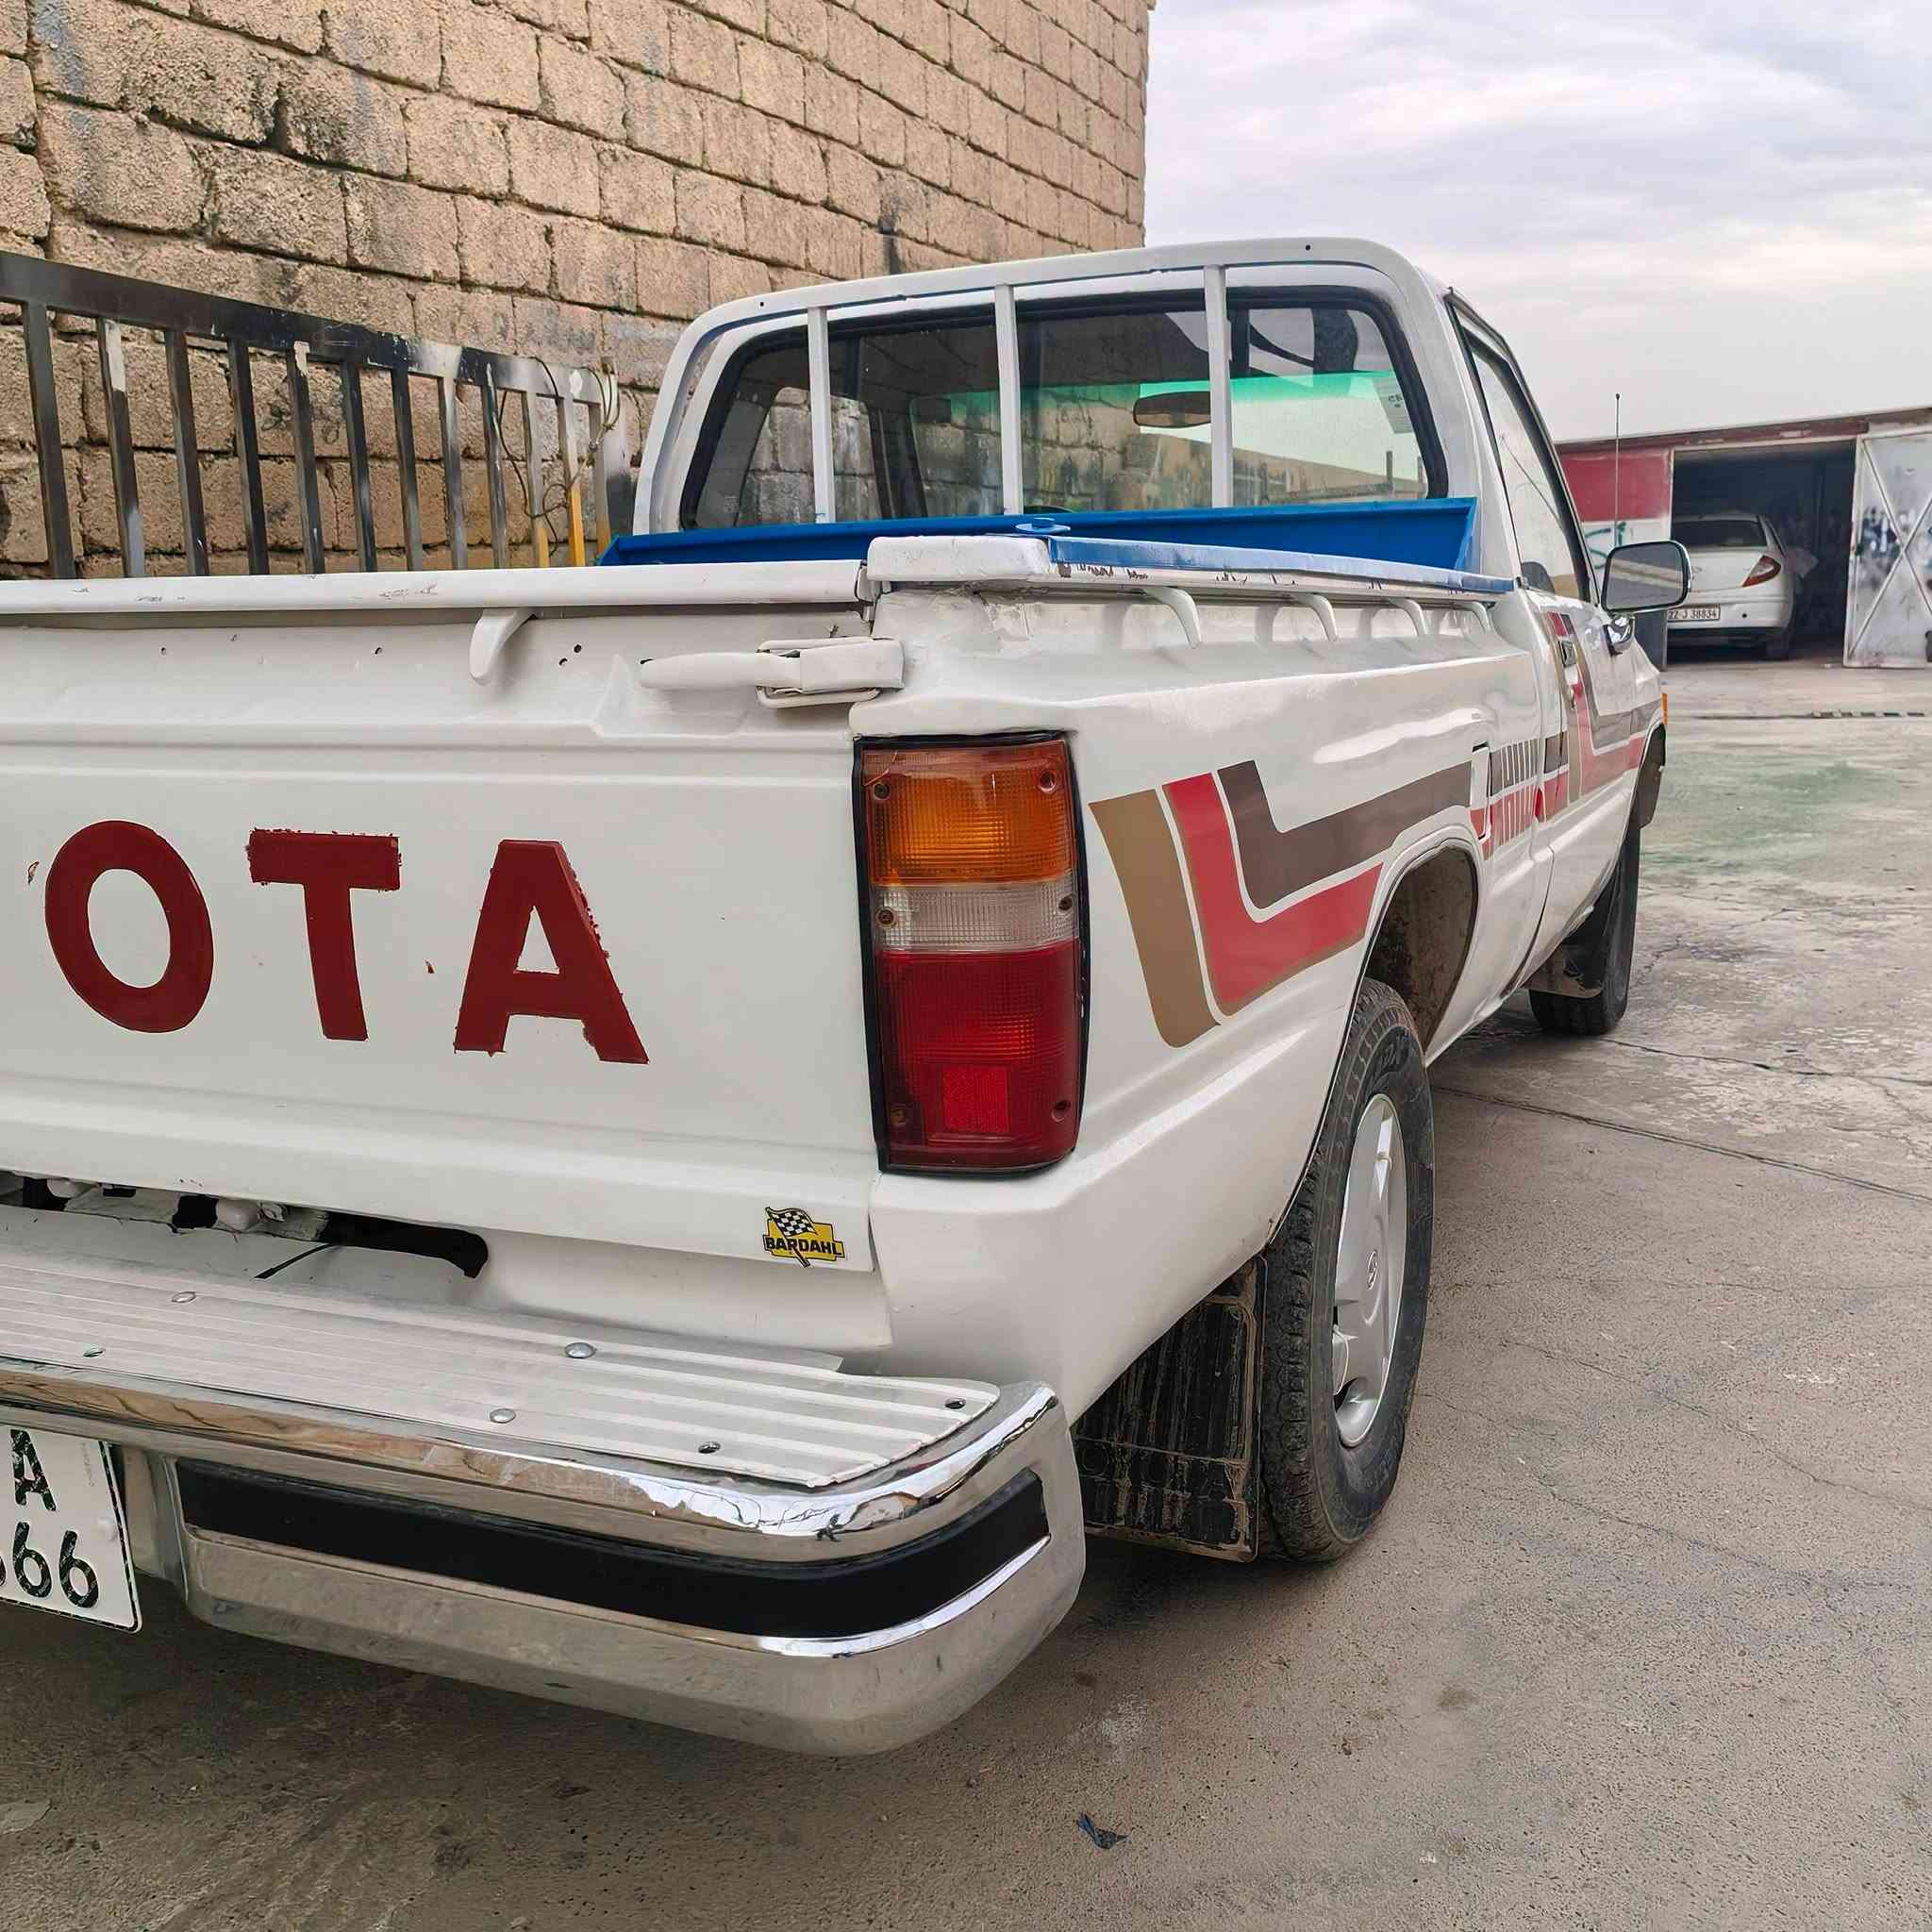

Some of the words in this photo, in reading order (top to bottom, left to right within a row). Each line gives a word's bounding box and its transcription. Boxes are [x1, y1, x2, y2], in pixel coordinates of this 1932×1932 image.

[45, 820, 648, 1064] OTA
[765, 1236, 842, 1256] BARDAHL
[10, 1429, 56, 1511] A
[0, 1522, 99, 1608] 66
